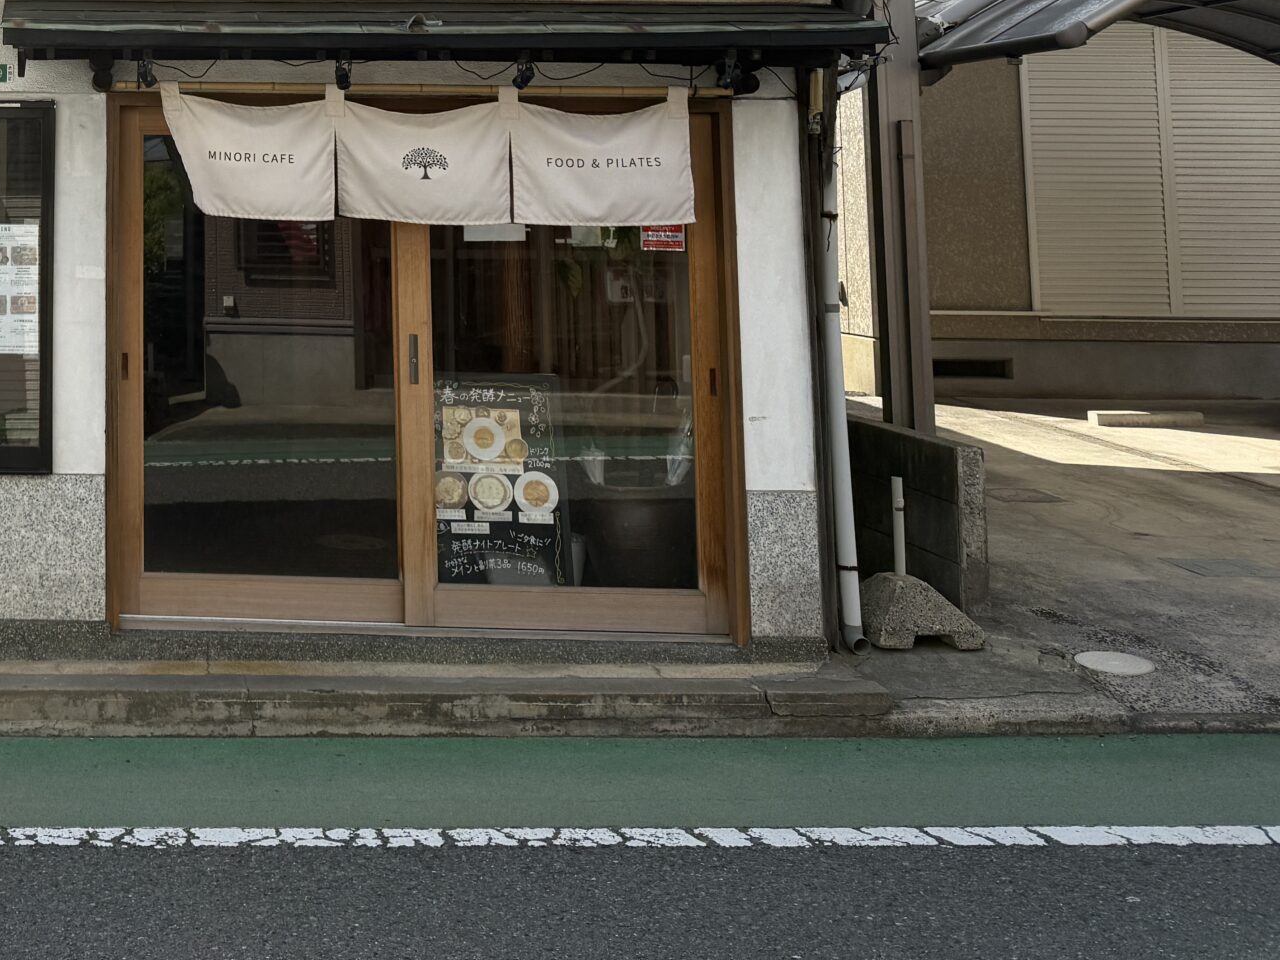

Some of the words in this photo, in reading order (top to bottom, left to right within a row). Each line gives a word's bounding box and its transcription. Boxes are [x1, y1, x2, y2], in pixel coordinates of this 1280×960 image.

[208, 150, 256, 162] MINORI
[262, 153, 295, 164] CAFE
[546, 157, 585, 168] FOOD
[591, 158, 601, 168] &
[606, 157, 662, 168] PILATES
[440, 386, 531, 404] 春の発酵メニュー
[451, 539, 522, 554] 発酵ナイトプレート
[517, 561, 545, 575] 1650円
